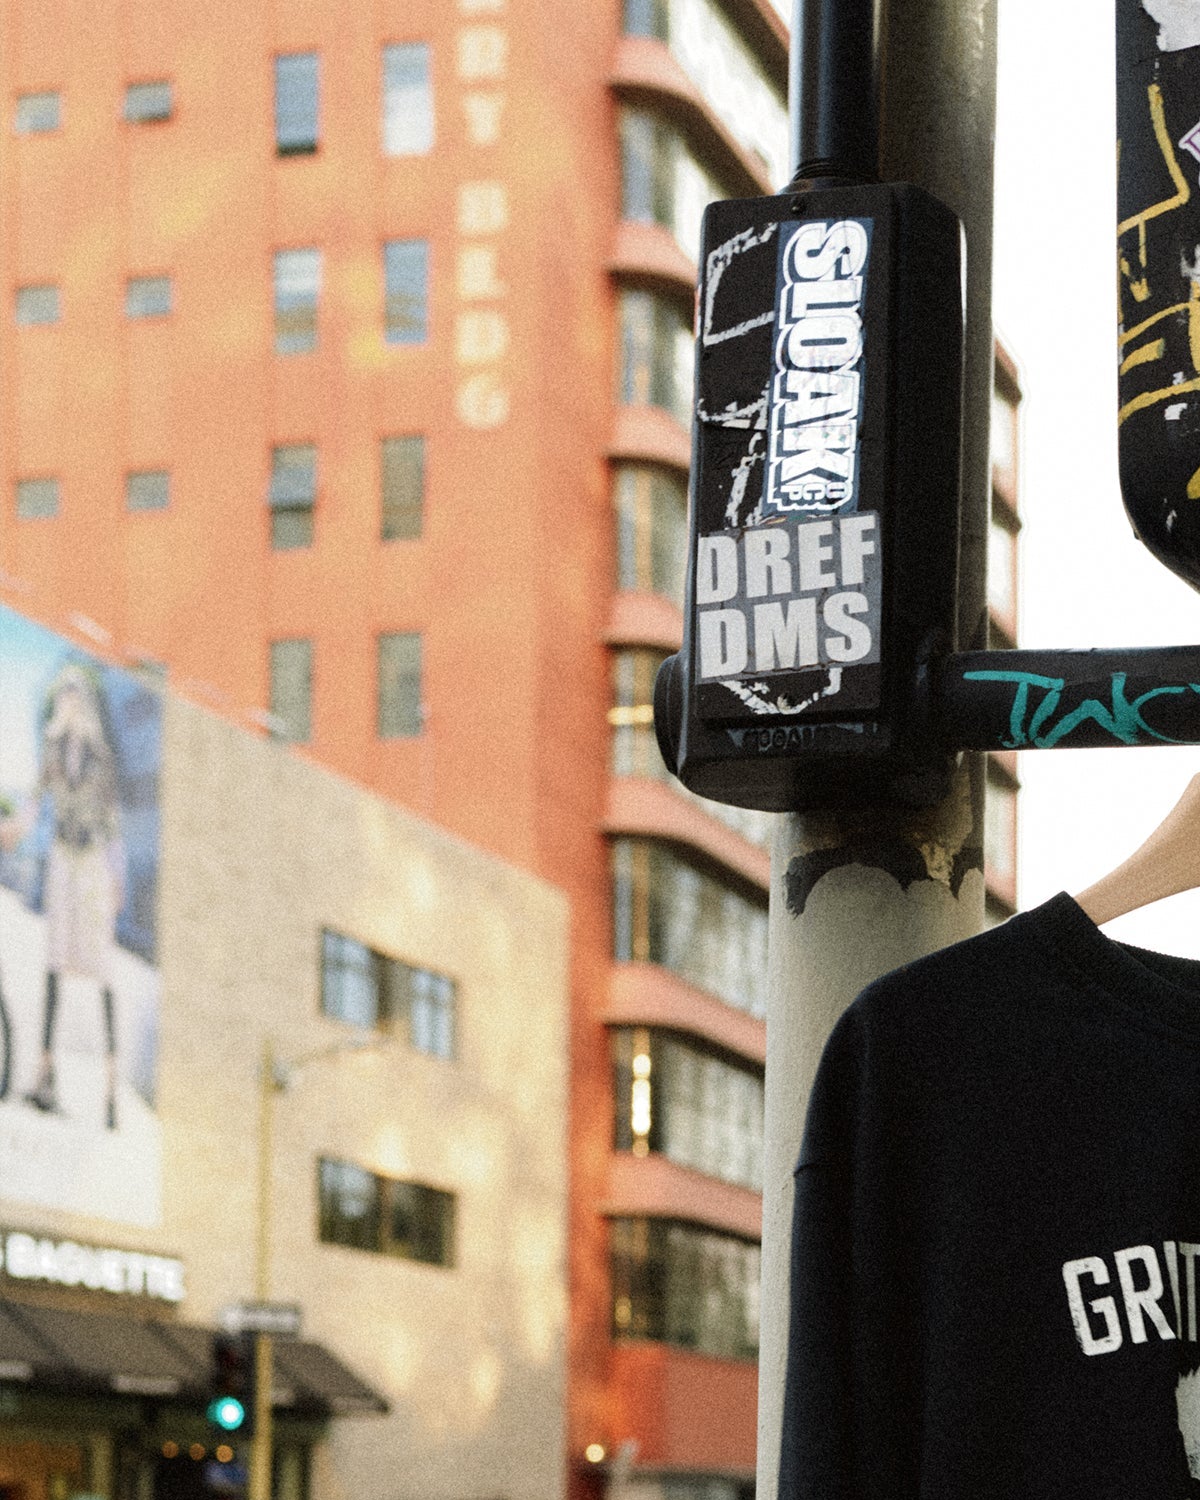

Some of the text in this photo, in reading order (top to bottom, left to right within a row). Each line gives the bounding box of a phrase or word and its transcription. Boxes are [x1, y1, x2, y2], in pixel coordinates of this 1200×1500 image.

[772, 219, 868, 490] SLOAK
[697, 515, 876, 605] DREF
[699, 591, 873, 679] DMS
